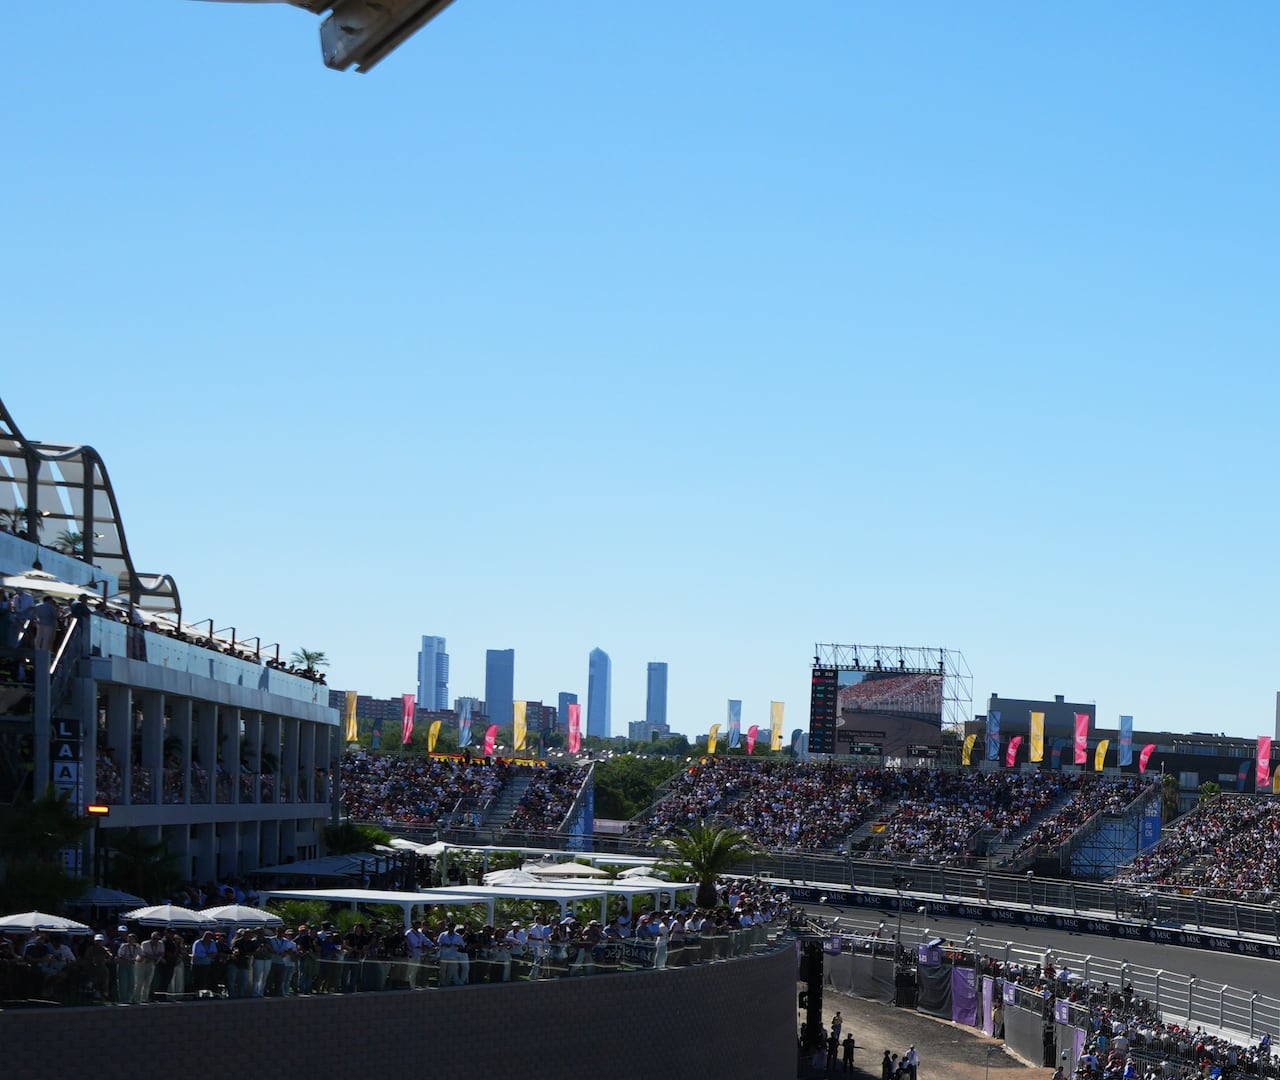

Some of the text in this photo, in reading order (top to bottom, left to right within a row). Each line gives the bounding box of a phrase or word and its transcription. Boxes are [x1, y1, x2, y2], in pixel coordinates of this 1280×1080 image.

[965, 906, 982, 916] MSC
[998, 910, 1015, 920] MSC
[1032, 914, 1048, 924] MSC
[1063, 918, 1079, 928] MSC
[1095, 922, 1111, 932] MSC
[1126, 926, 1141, 936] MSC
[1156, 930, 1171, 940] MSC
[1186, 934, 1201, 944] MSC
[1216, 938, 1231, 948] MSC
[1245, 942, 1260, 952] MSC
